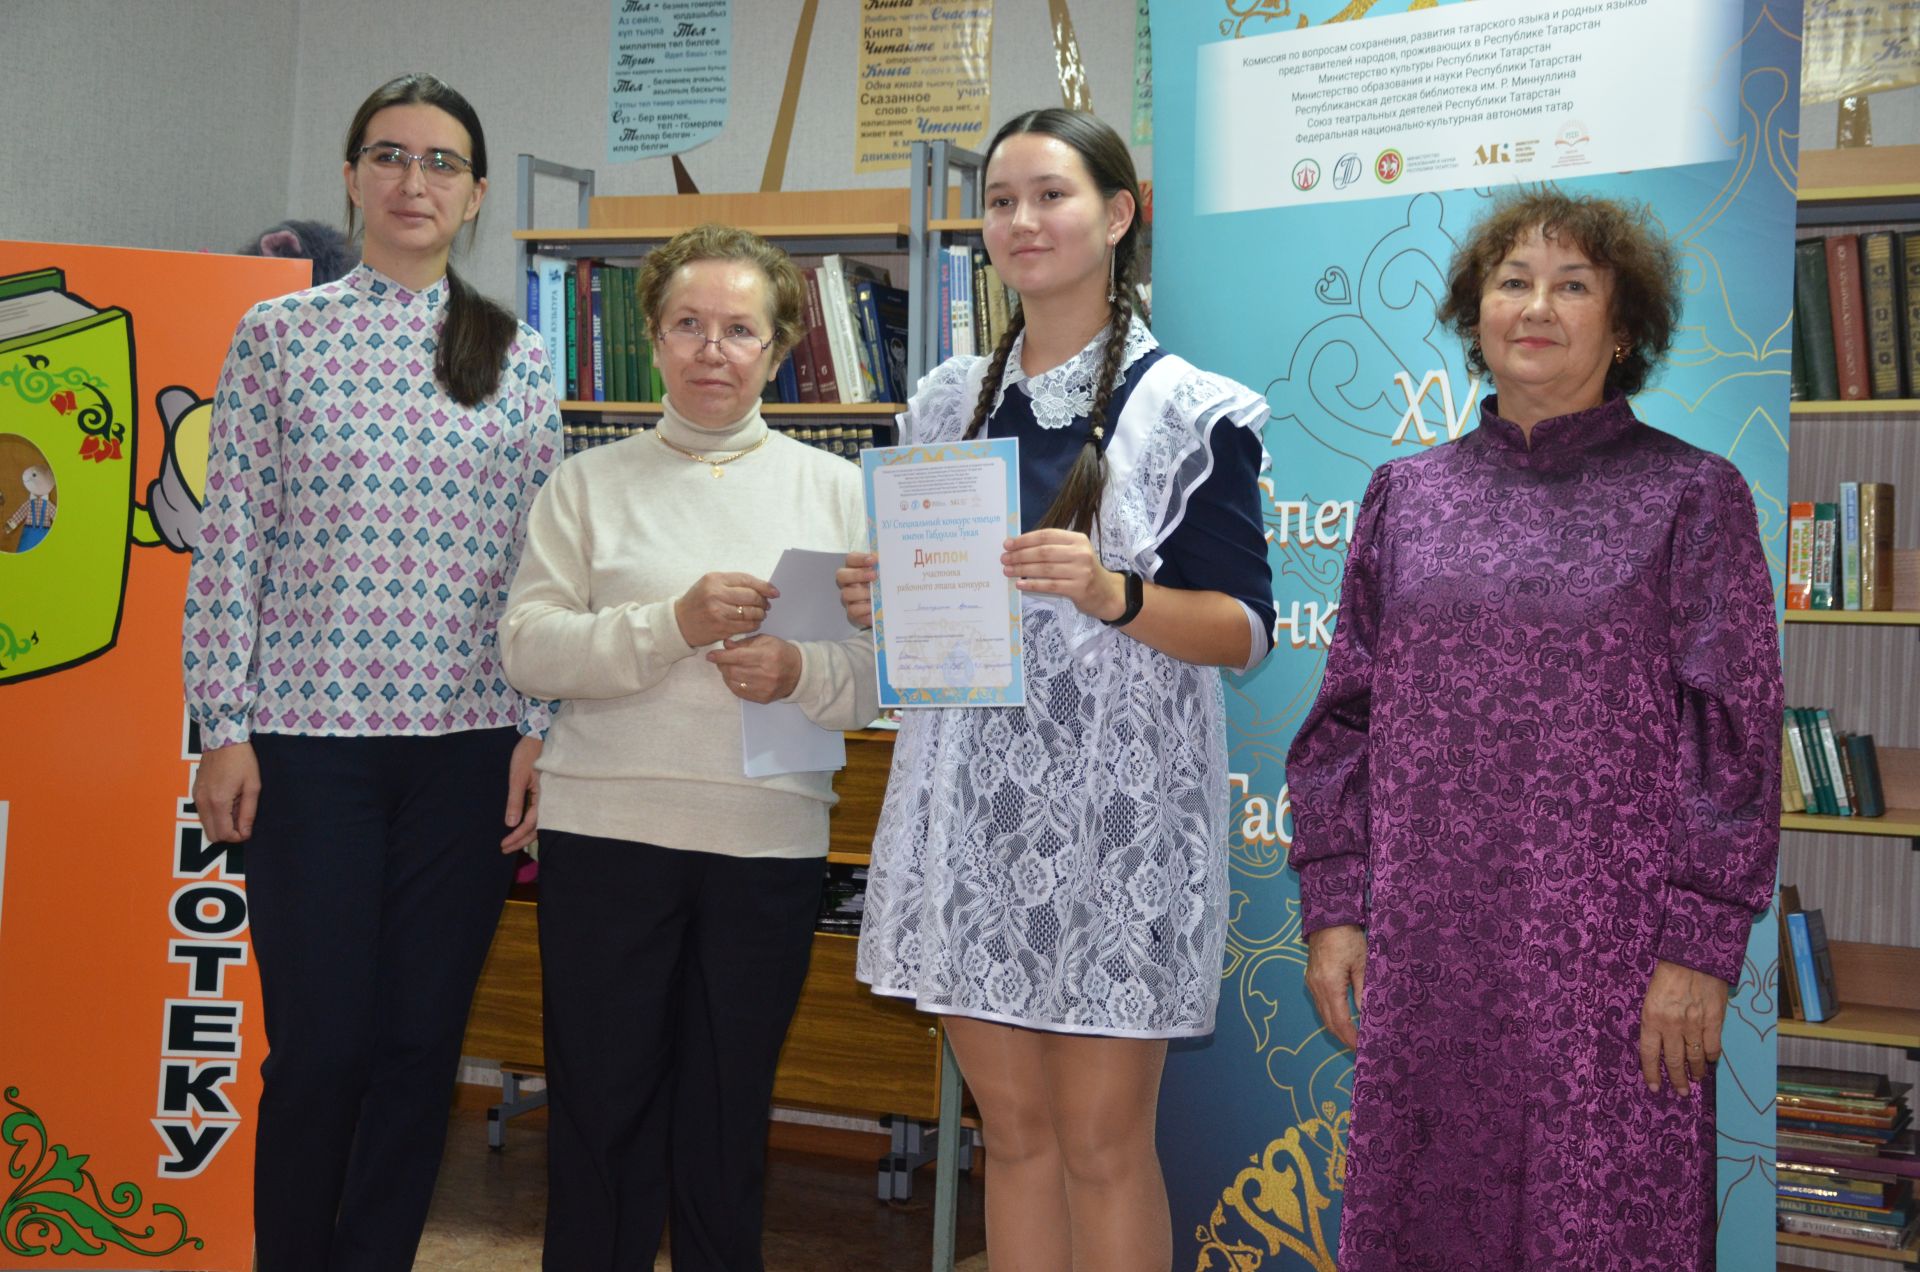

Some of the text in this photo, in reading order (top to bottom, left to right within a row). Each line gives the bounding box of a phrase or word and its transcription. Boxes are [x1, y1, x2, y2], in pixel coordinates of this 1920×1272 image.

[618, 17, 630, 25] Аз
[673, 22, 707, 38] Тел
[864, 27, 903, 39] Книга
[1242, 0, 1648, 68] Комиссия по вопросам сохранения, развития татарского языка и родных языков
[864, 40, 935, 55] Читайте
[1278, 18, 1601, 76] представителей народов, проживающих в Республике Татарстан
[617, 54, 655, 69] Туган
[1318, 42, 1551, 85] Министерство культуры Республики Татарстан
[862, 63, 912, 78] Книга
[1291, 53, 1582, 102] Министерство образования и науки Республики Татарстан
[613, 80, 643, 93] Тел
[865, 81, 892, 90] Одна
[894, 80, 924, 89] книга
[1295, 69, 1576, 115] Республиканская детская библиотека им. Р. Миннуллина
[860, 92, 931, 105] Сказанное
[957, 87, 989, 100] учит
[875, 107, 908, 116] слово
[916, 105, 941, 113] было
[1307, 86, 1561, 129] Союз театральных деятелей Республики Татарстан
[638, 113, 655, 122] бер
[860, 119, 912, 128] написанное
[1295, 100, 1574, 145] Федеральная национально-культурная автономия татар
[915, 116, 983, 135] Чтение
[860, 130, 887, 138] живет
[861, 151, 912, 163] движени
[550, 290, 558, 333] КУЛЬТУРА
[592, 314, 603, 392] ДРЕВНИЙ МИР
[800, 364, 807, 376] 7
[821, 364, 828, 376] 6
[893, 517, 941, 529] Специальный
[942, 515, 971, 527] конкурс
[902, 528, 979, 541] имени Габдуллы Тукая
[914, 548, 969, 568] Диплом
[958, 580, 990, 591] конкурса
